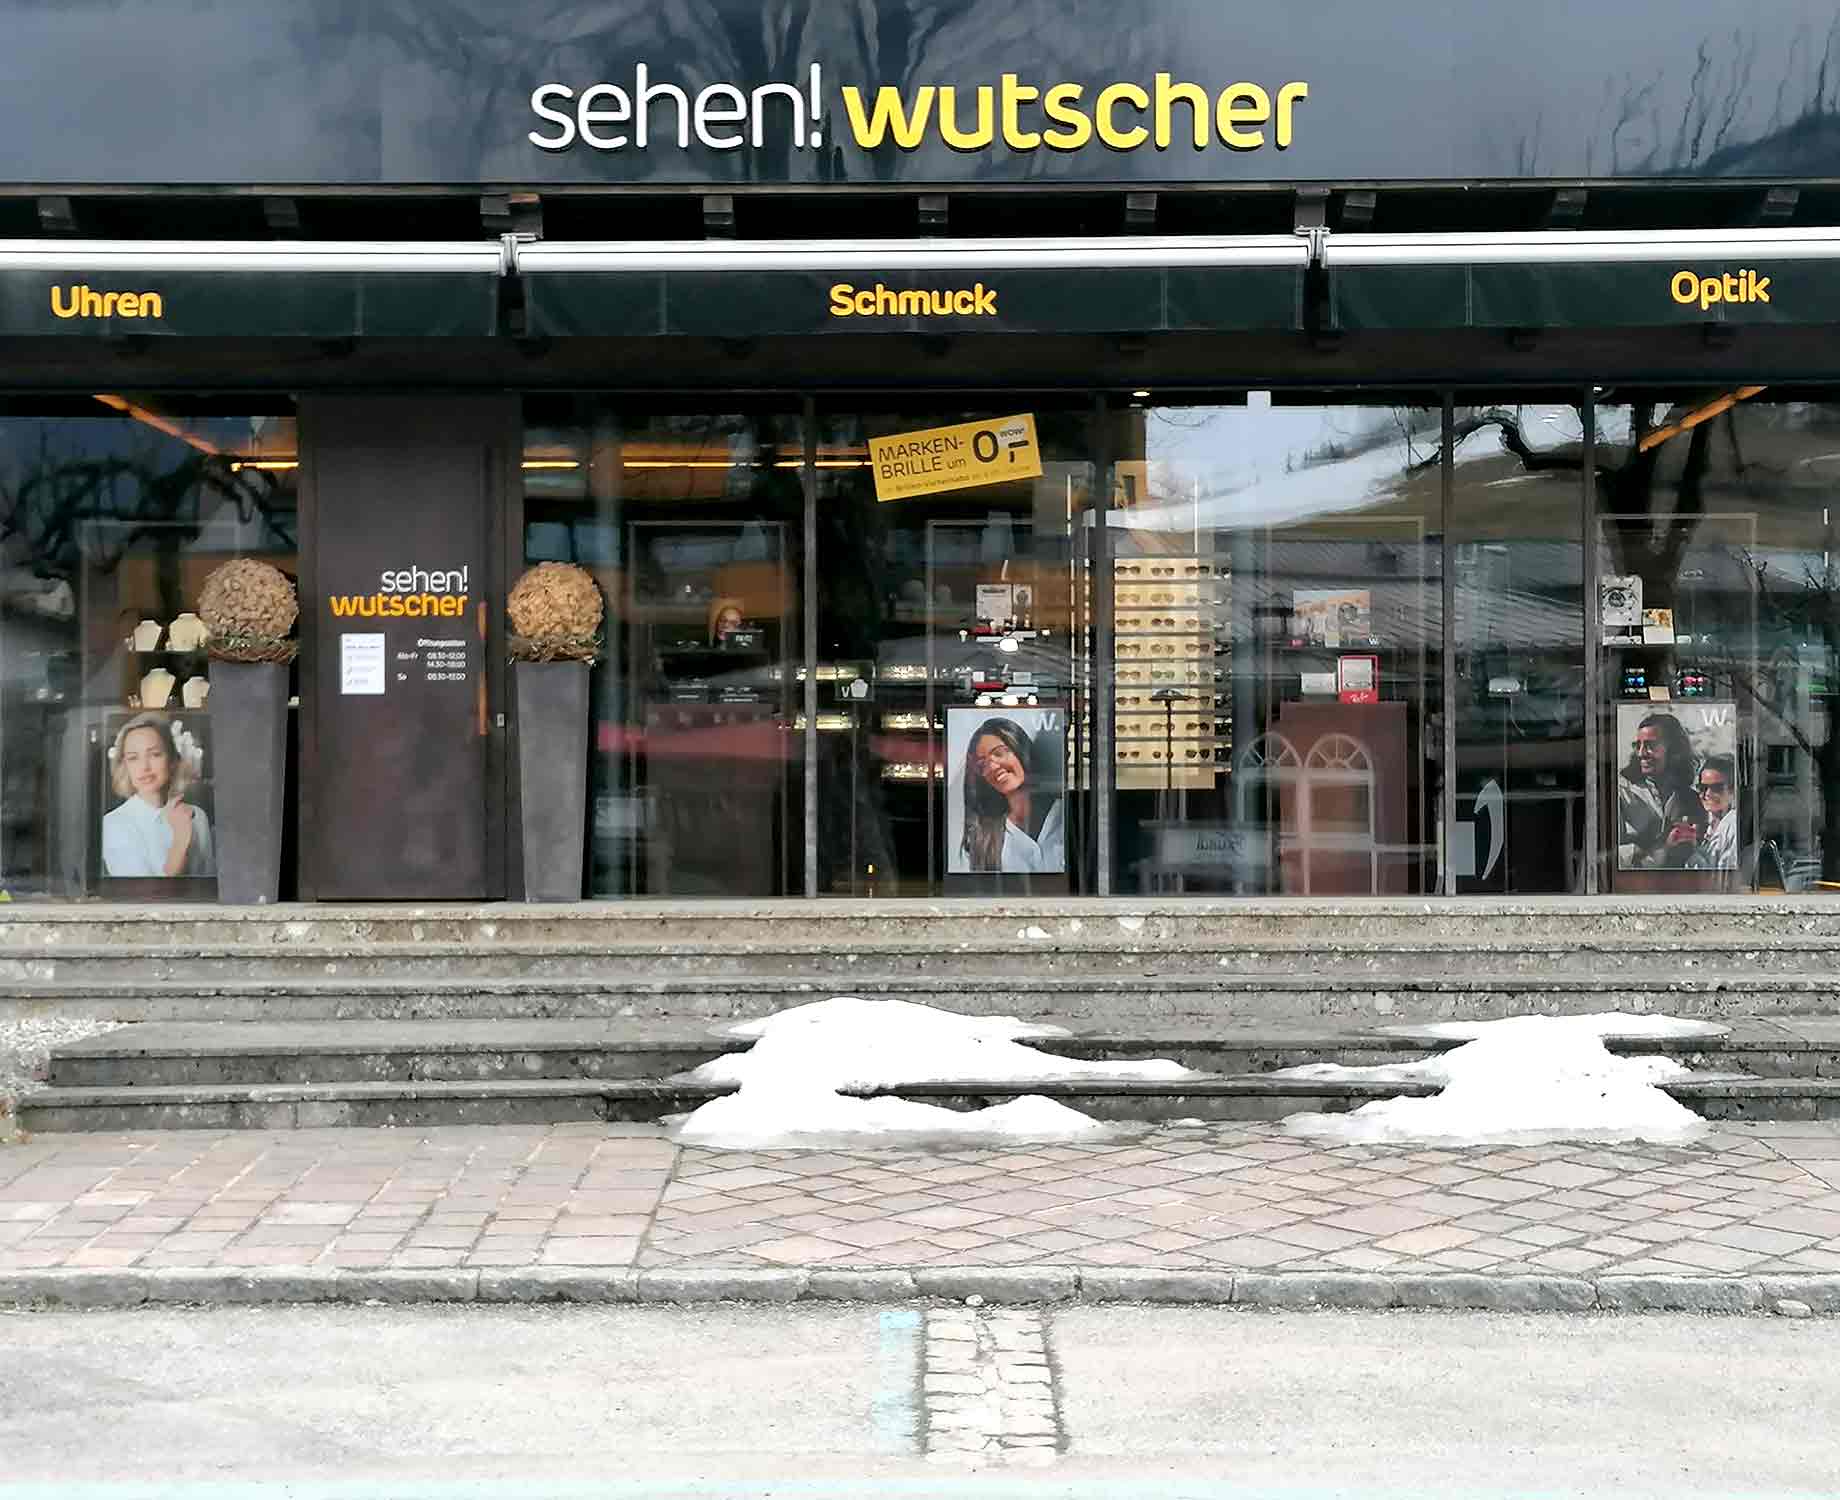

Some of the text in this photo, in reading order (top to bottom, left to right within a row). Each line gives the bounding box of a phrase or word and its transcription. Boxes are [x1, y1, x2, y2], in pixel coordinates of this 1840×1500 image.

[528, 62, 1308, 150] sehen! wutscher
[51, 285, 162, 318] Uhren
[830, 283, 997, 316] Schmuck
[1671, 269, 1770, 310] Optik
[879, 435, 965, 463] MARKEN-
[881, 455, 967, 480] BRILLE um
[381, 565, 468, 593] sehen!
[330, 592, 468, 617] wutscher
